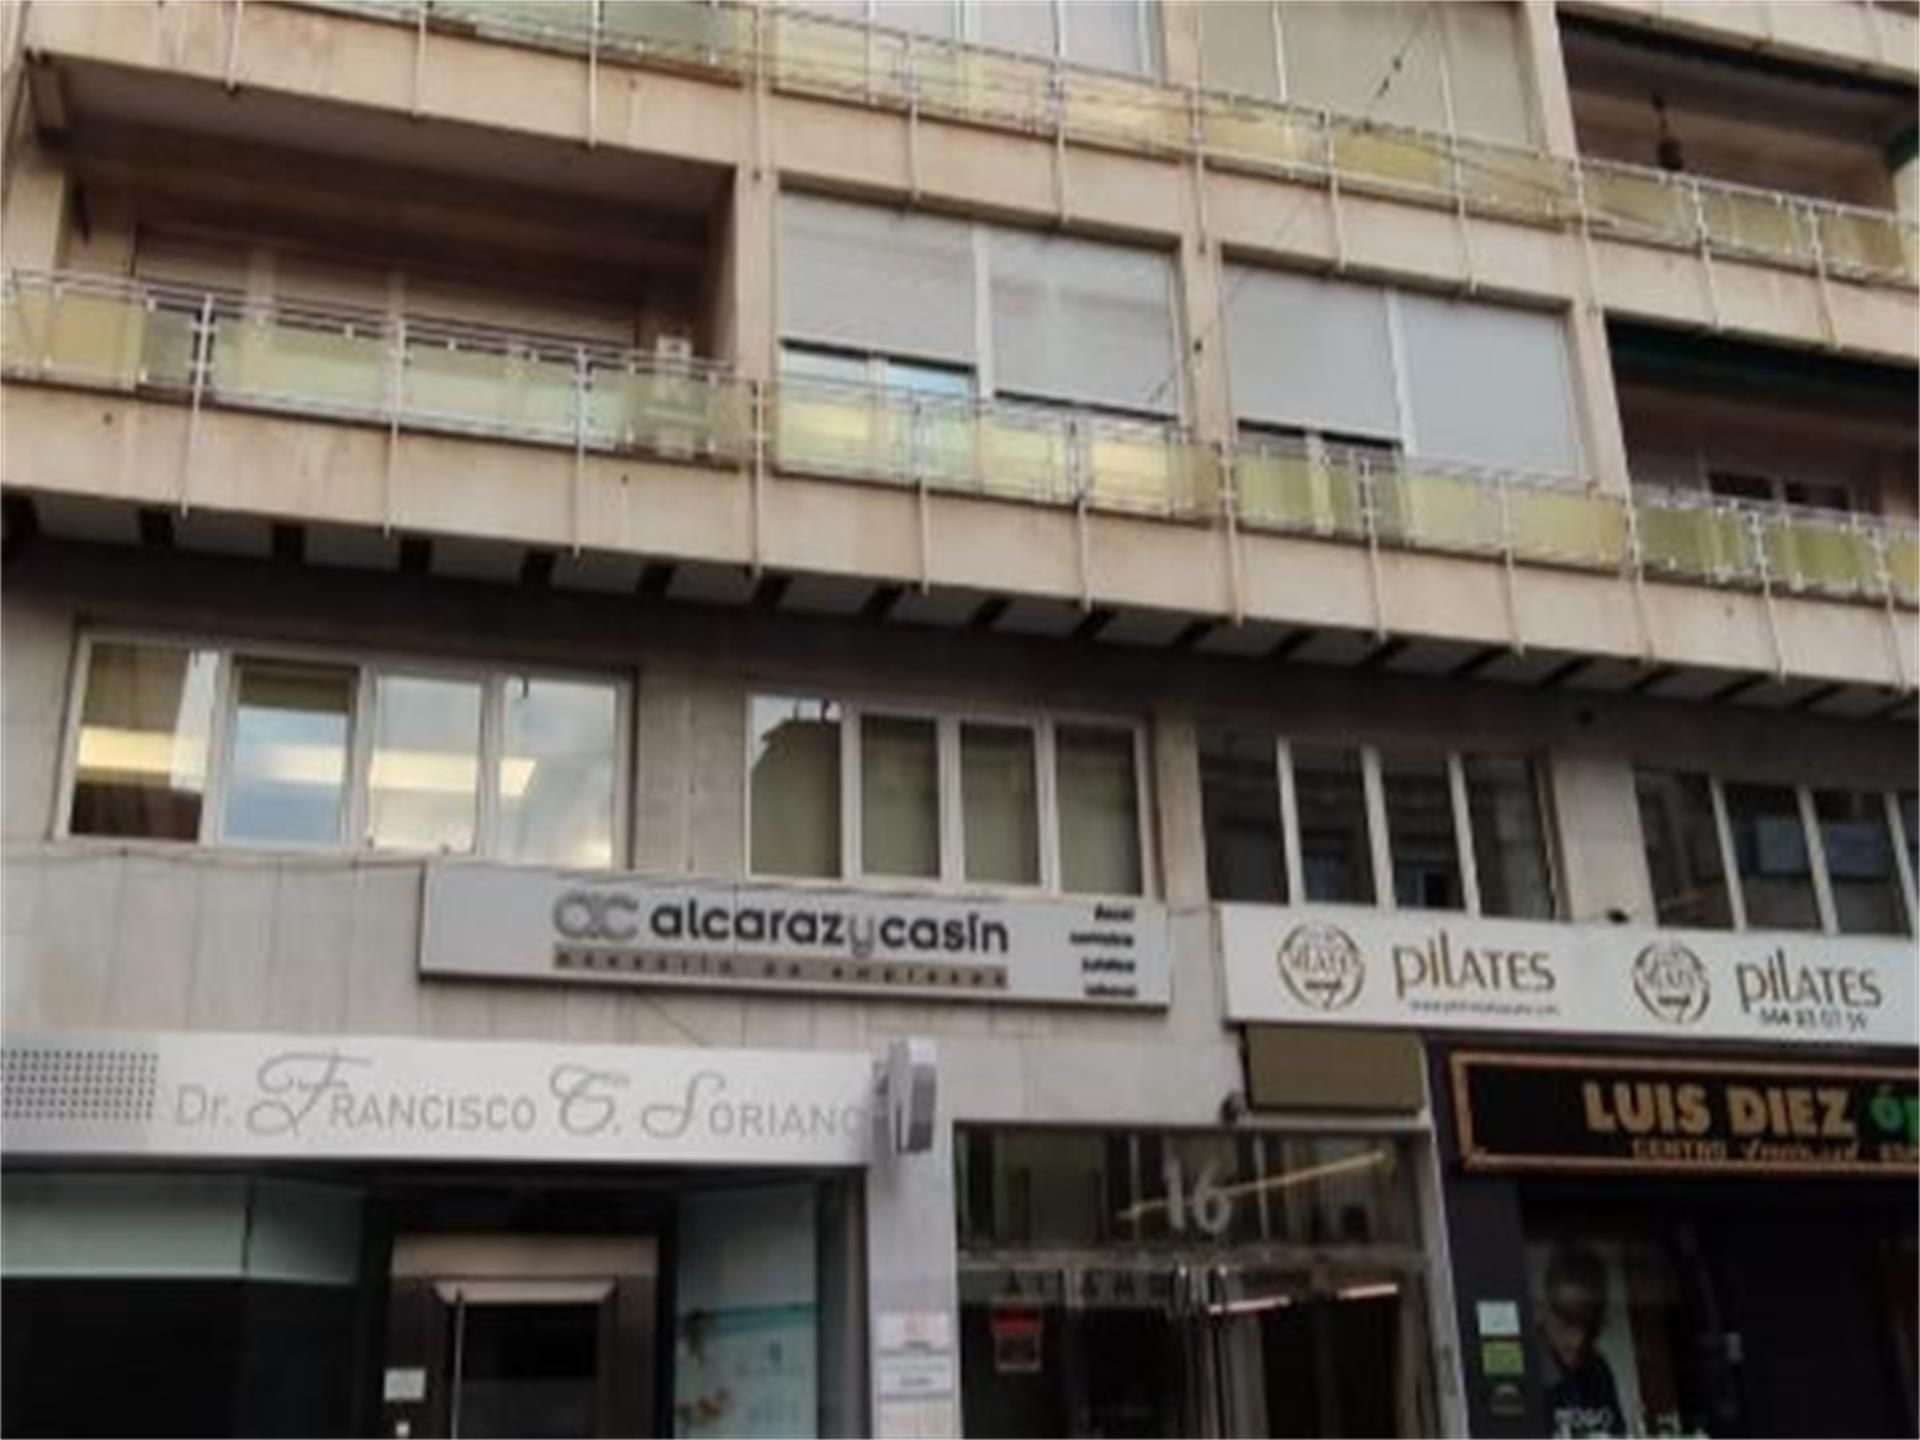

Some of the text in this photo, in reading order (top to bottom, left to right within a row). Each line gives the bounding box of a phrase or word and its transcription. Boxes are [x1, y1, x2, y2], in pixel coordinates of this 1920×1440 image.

[175, 1083, 235, 1127] Dr.
[1582, 1080, 1711, 1134] LUIS
[1726, 1085, 1856, 1138] DIEZ
